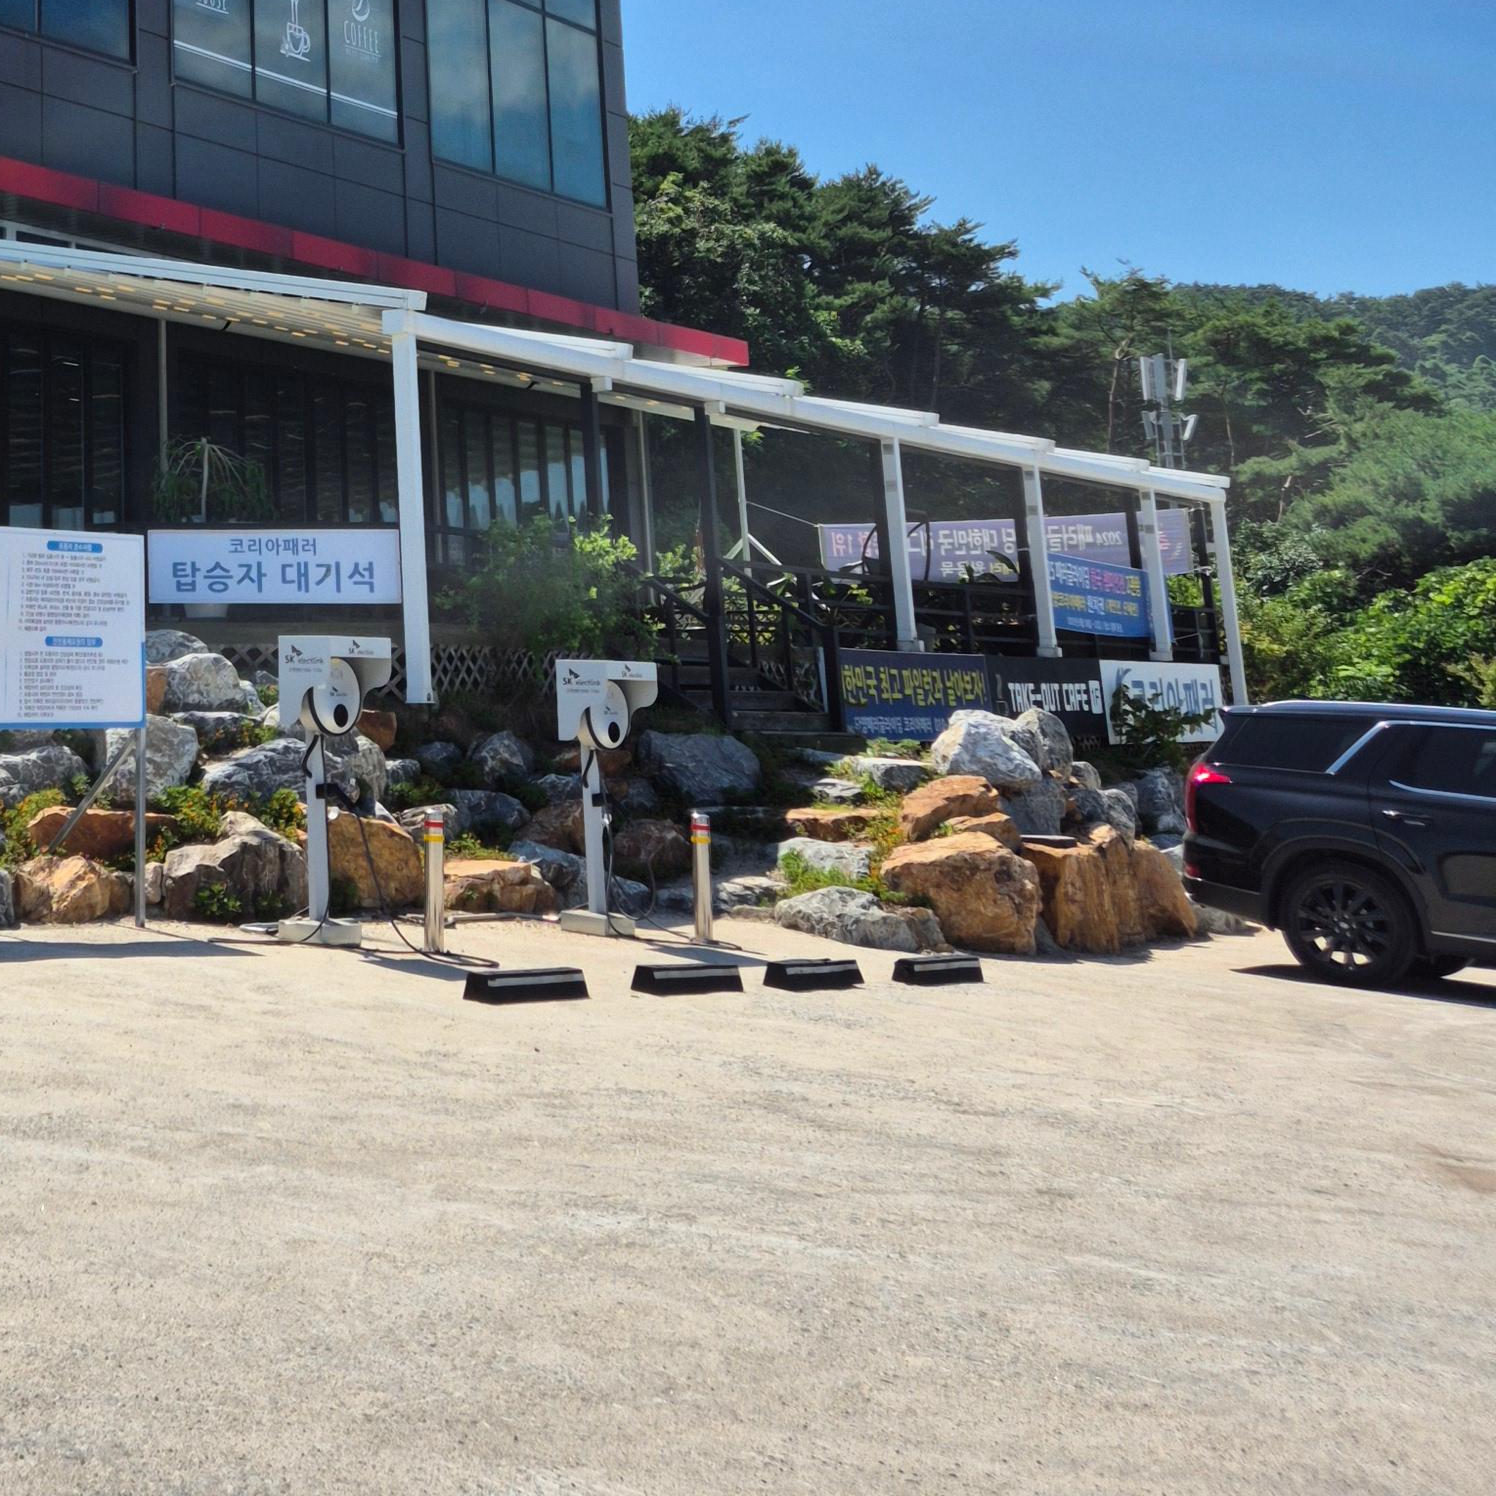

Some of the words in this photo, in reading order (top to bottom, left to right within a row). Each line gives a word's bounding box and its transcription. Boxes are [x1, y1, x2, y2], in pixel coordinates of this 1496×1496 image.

[343, 20, 380, 54] COFFEE
[229, 537, 318, 557] 코리아패러
[171, 560, 268, 594] 탑승자
[280, 560, 376, 594] 대기석
[285, 654, 296, 664] SK
[563, 677, 572, 686] SK
[840, 664, 879, 705] 한민국
[879, 665, 903, 705] 최고
[901, 667, 945, 707] 파일럿과
[1007, 682, 1062, 713] TAKE-OUT
[1061, 682, 1090, 712] CAFE
